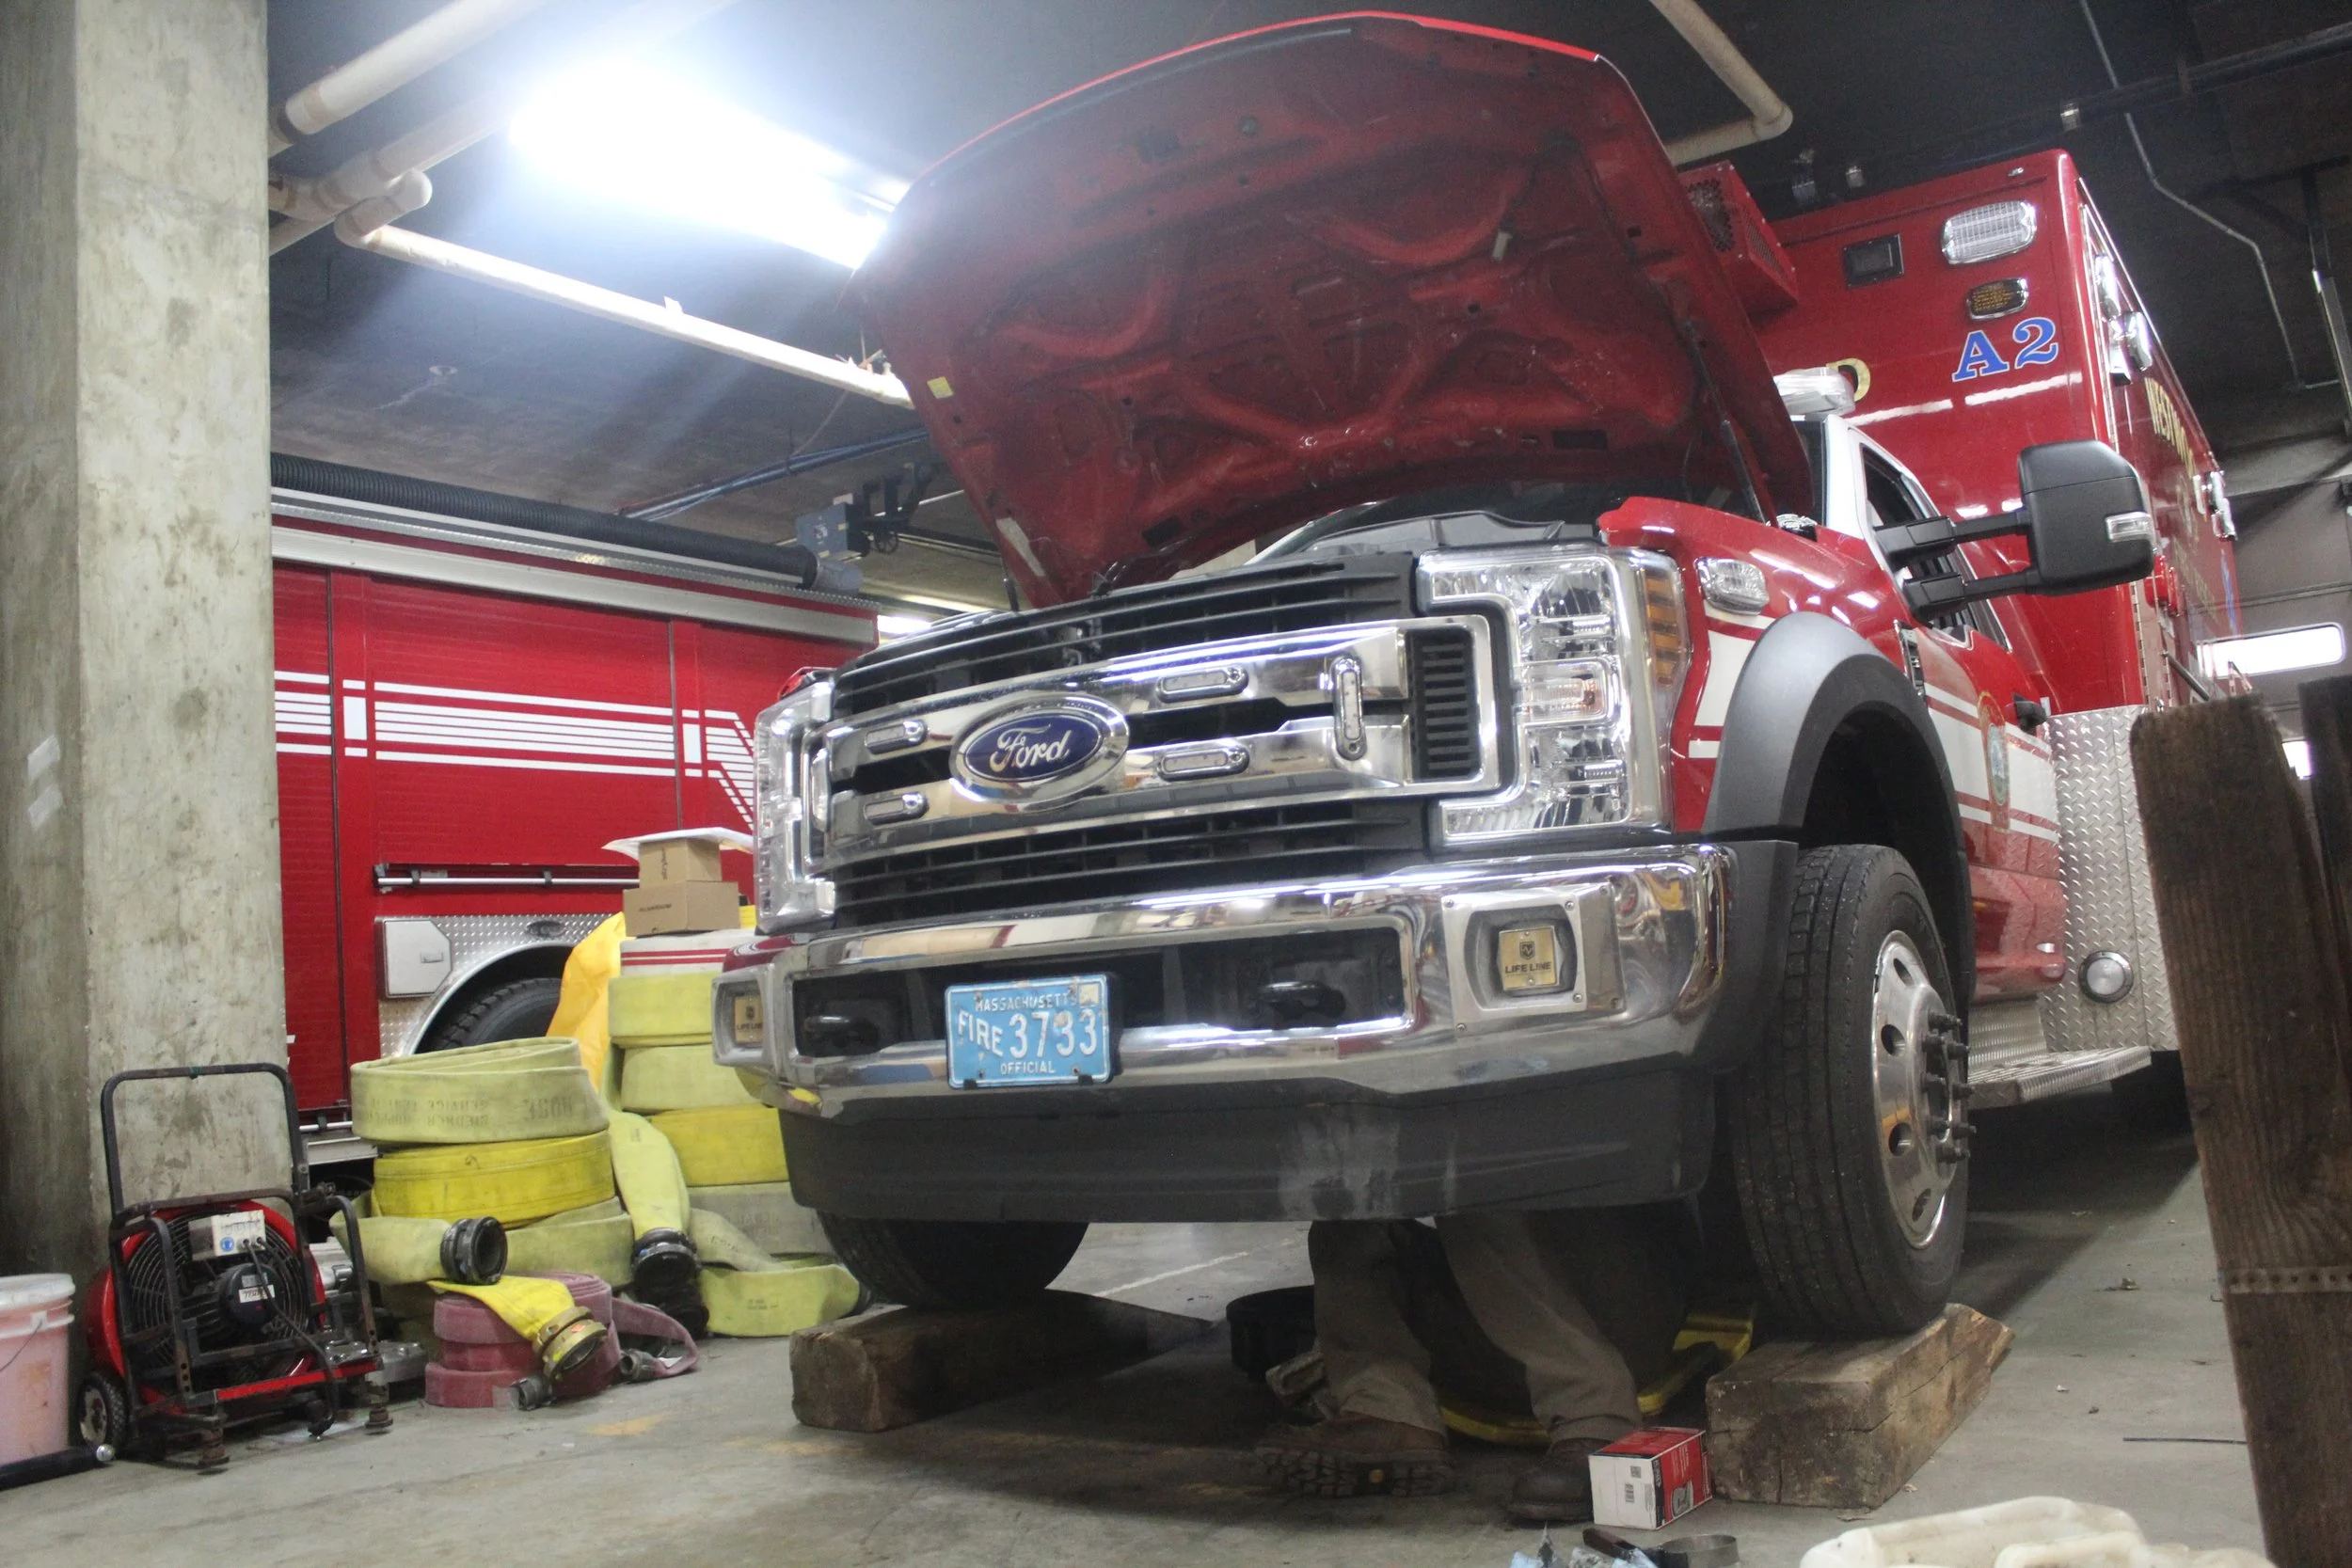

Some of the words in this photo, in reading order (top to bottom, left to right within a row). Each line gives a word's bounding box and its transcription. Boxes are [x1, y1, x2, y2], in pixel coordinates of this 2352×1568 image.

[1951, 316, 2059, 383] A2
[989, 722, 1073, 772] Ford
[1504, 963, 1529, 974] LIFE
[1529, 961, 1552, 972] LINE
[975, 992, 1078, 1013] MASSACHUSETTS
[957, 1009, 1005, 1058] FIRE
[1008, 1007, 1098, 1060] 3733
[999, 1060, 1057, 1075] OFFICIAL
